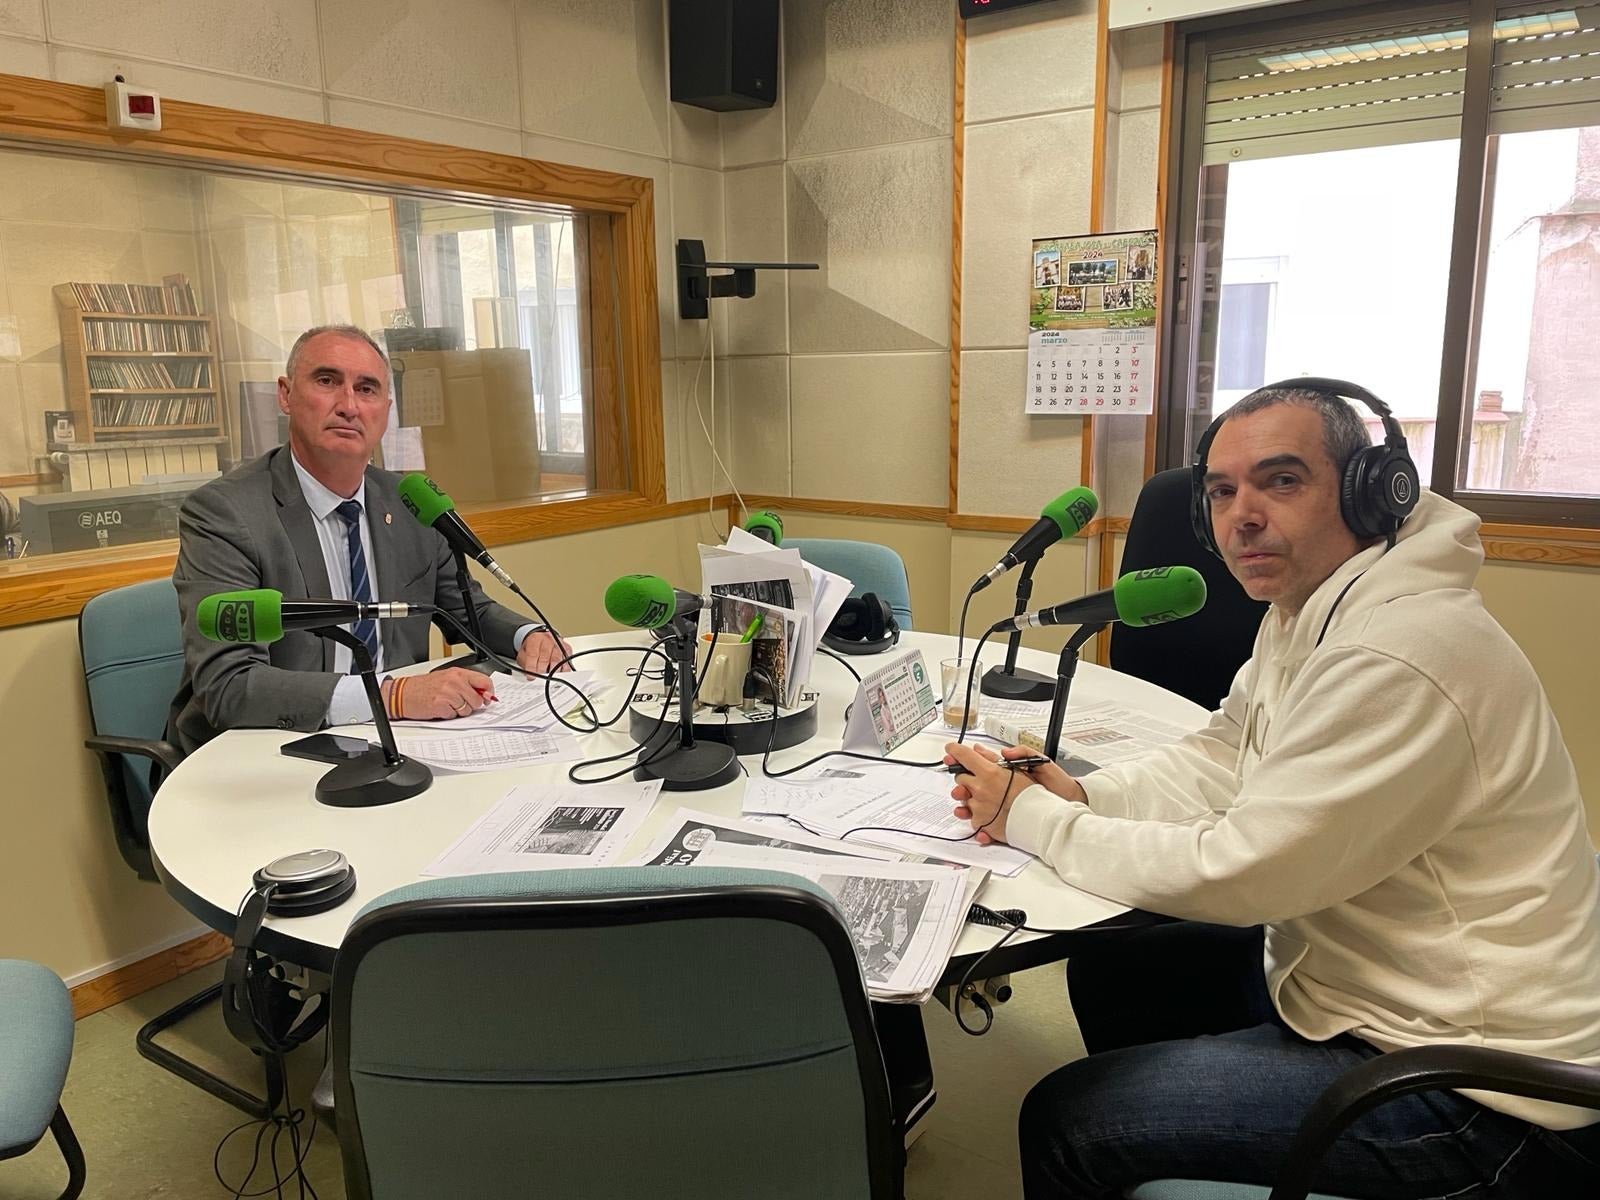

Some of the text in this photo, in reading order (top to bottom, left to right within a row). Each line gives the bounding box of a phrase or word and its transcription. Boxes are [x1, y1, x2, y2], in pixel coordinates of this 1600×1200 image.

[1083, 250, 1103, 259] 2024
[96, 510, 122, 526] AEQ
[239, 607, 249, 640] CERO
